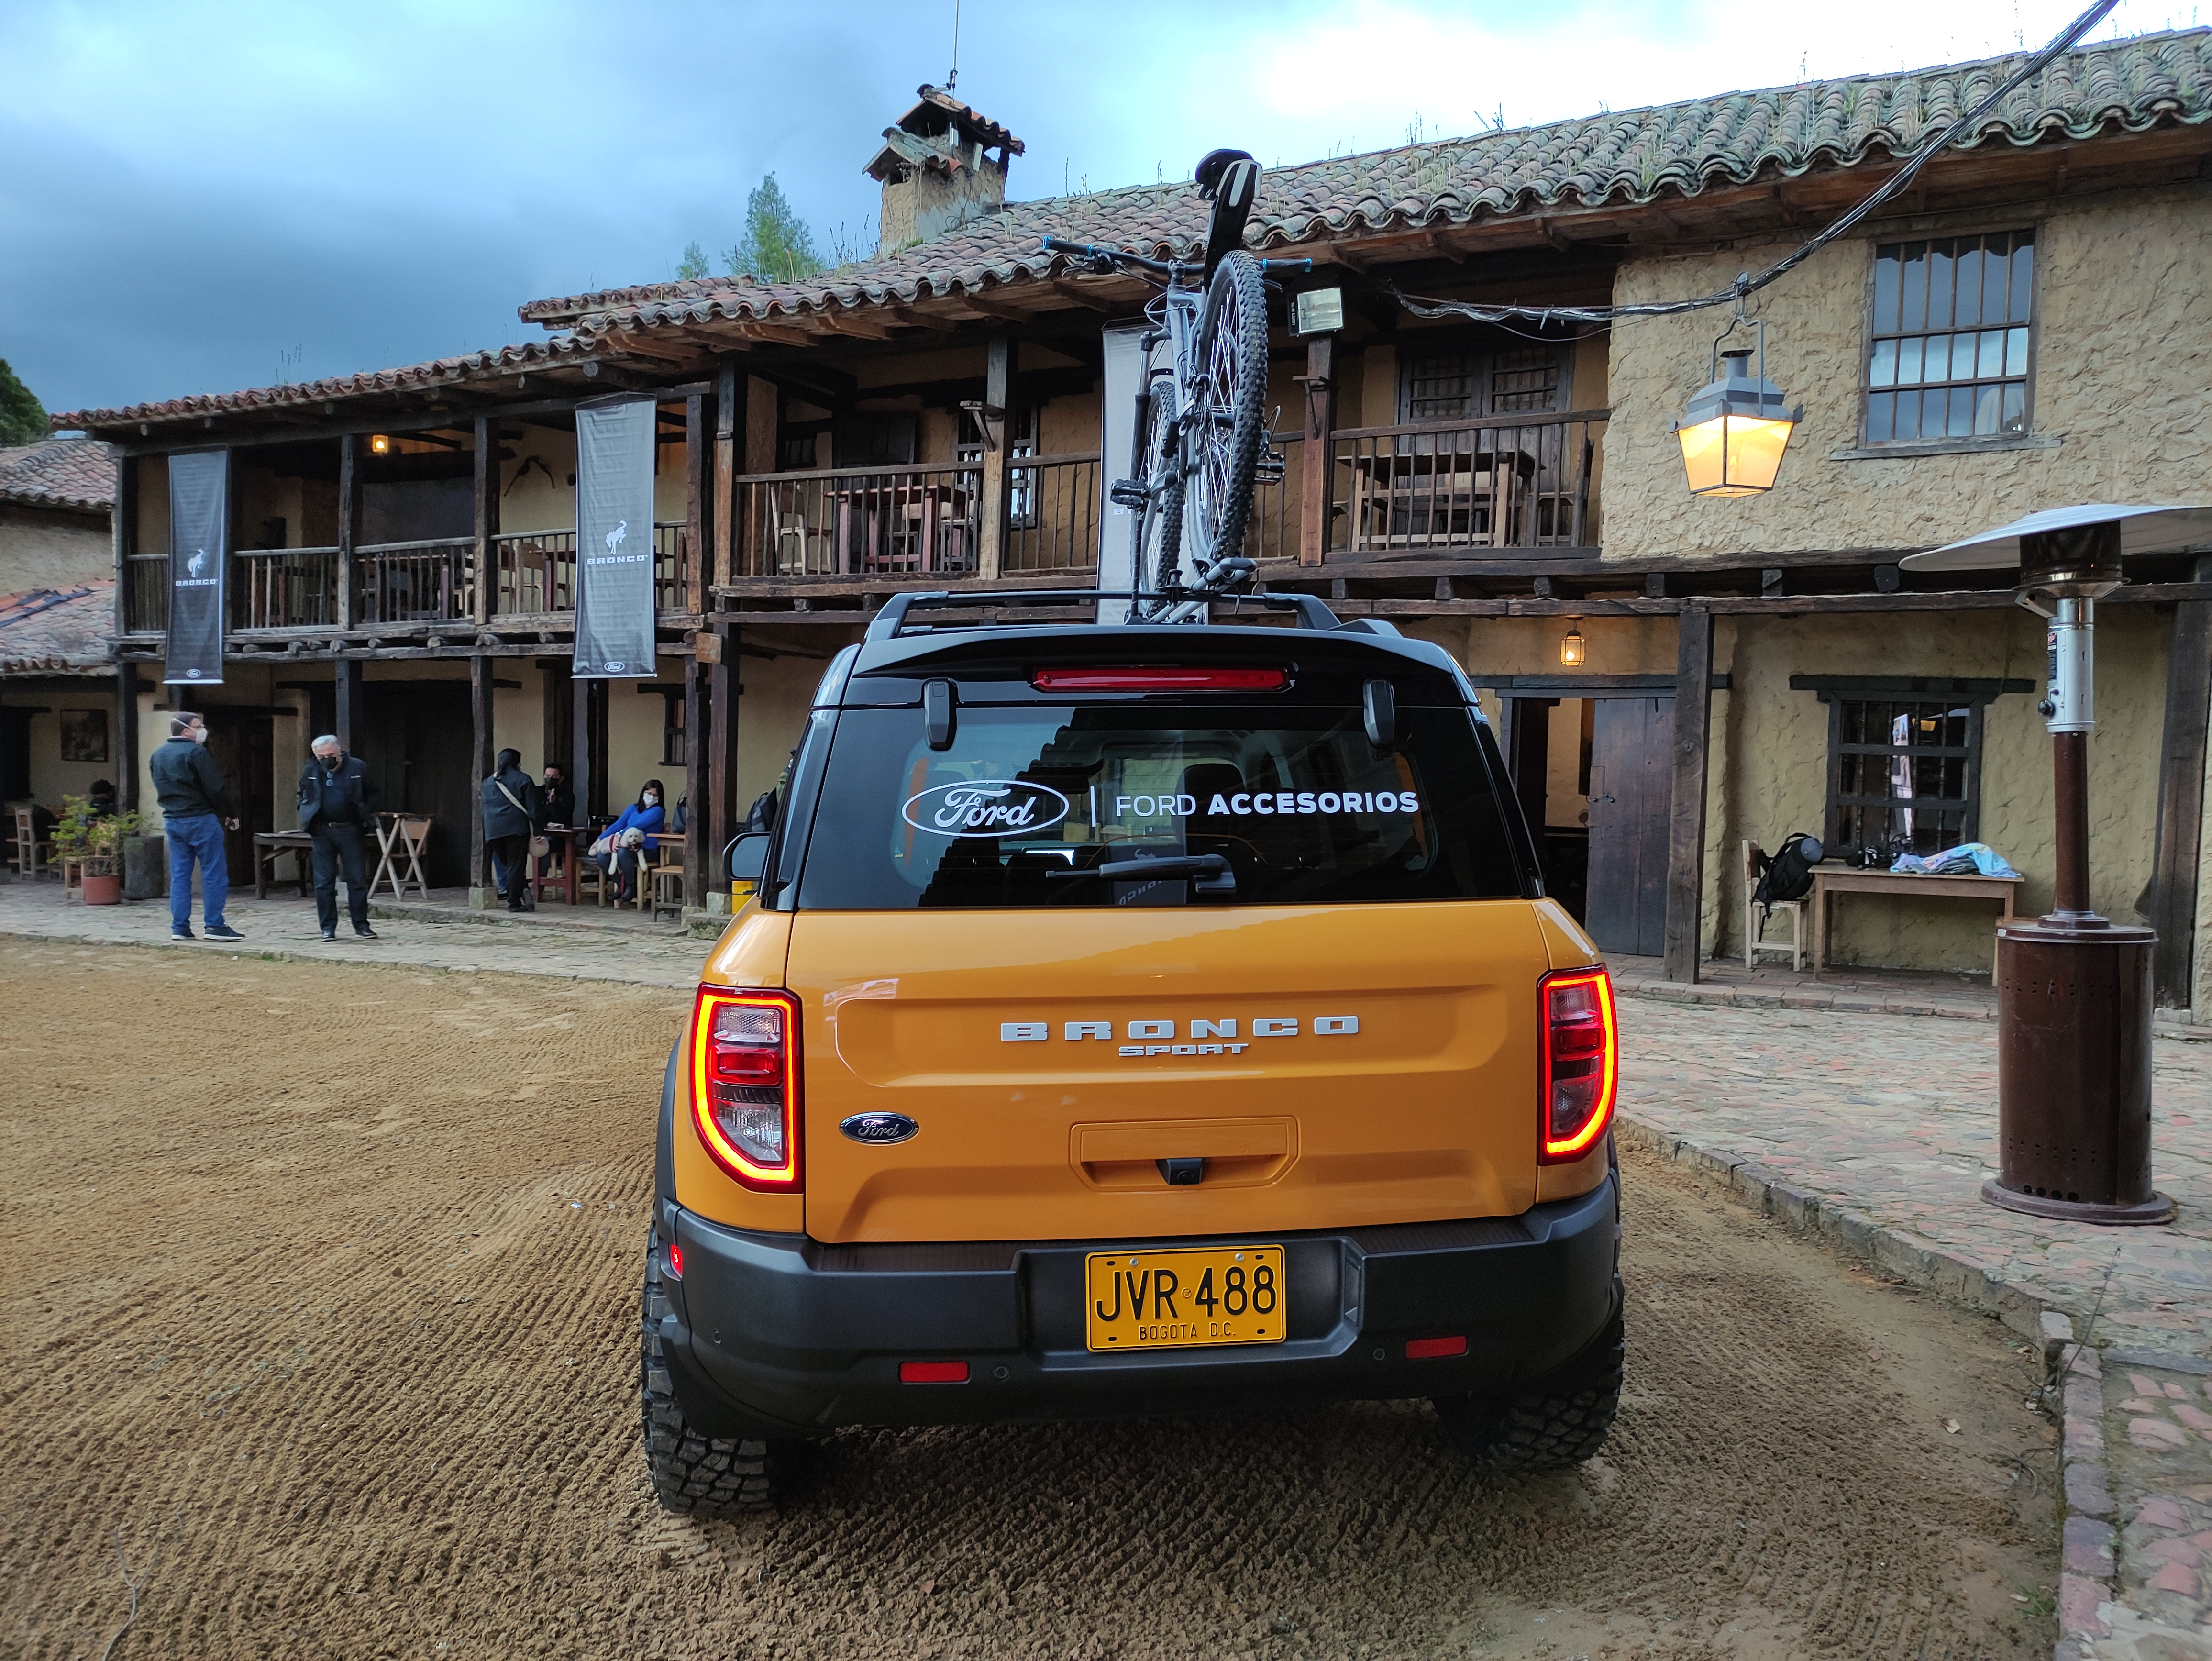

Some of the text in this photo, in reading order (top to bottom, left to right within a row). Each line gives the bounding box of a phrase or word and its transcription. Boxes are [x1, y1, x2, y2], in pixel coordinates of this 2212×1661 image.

[586, 555, 645, 565] BRONCO
[934, 788, 1037, 827] Ford
[1116, 792, 1419, 817] FORD ACCESORIOS
[1000, 1016, 1359, 1041] BRONCO
[1118, 1043, 1249, 1057] SPORT
[857, 1118, 900, 1137] Ford
[1096, 1265, 1276, 1322] JVR 488
[1139, 1322, 1236, 1340] BOGOTA D.C.
